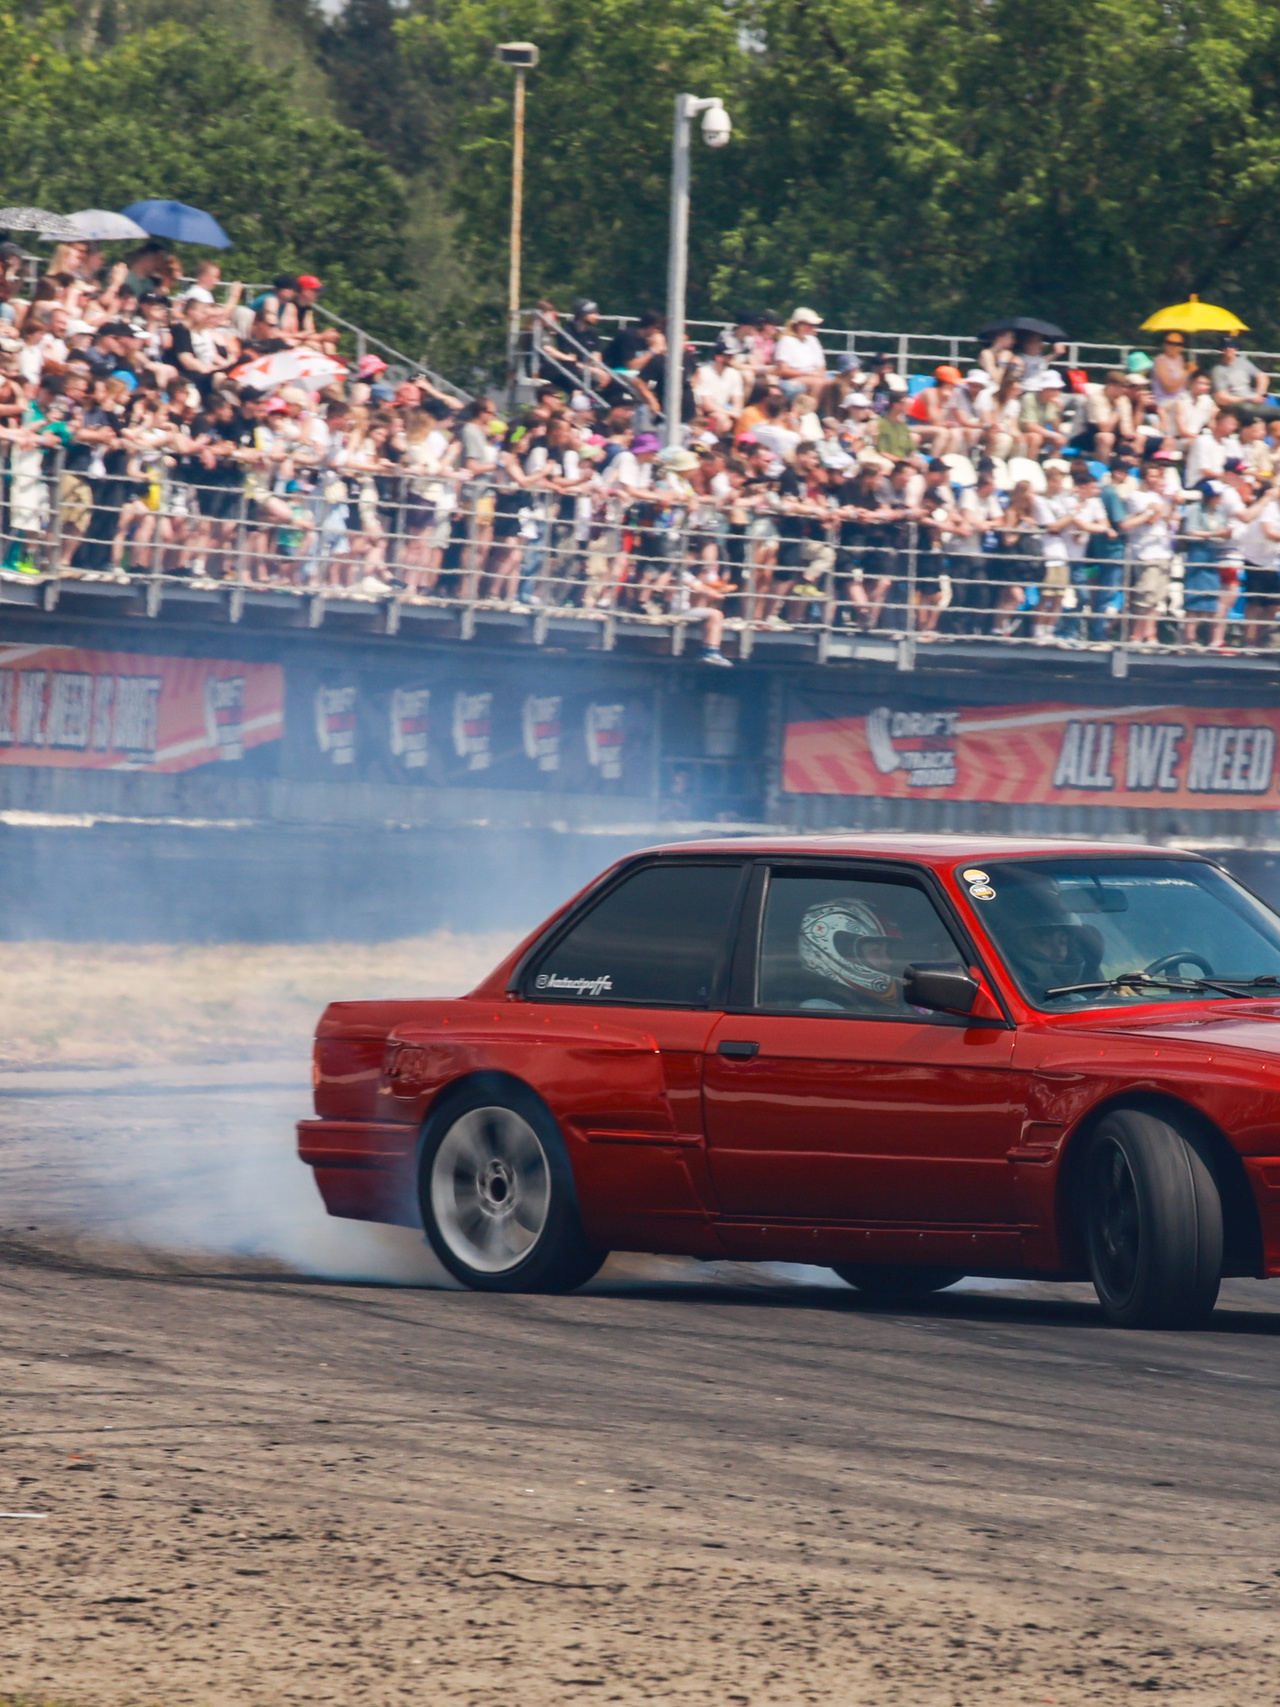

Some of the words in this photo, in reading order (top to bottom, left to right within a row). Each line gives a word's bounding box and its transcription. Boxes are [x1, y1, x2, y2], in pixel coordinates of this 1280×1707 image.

[1054, 722, 1114, 789] ALL
[1127, 724, 1185, 791] WE
[1188, 726, 1276, 793] NEED
